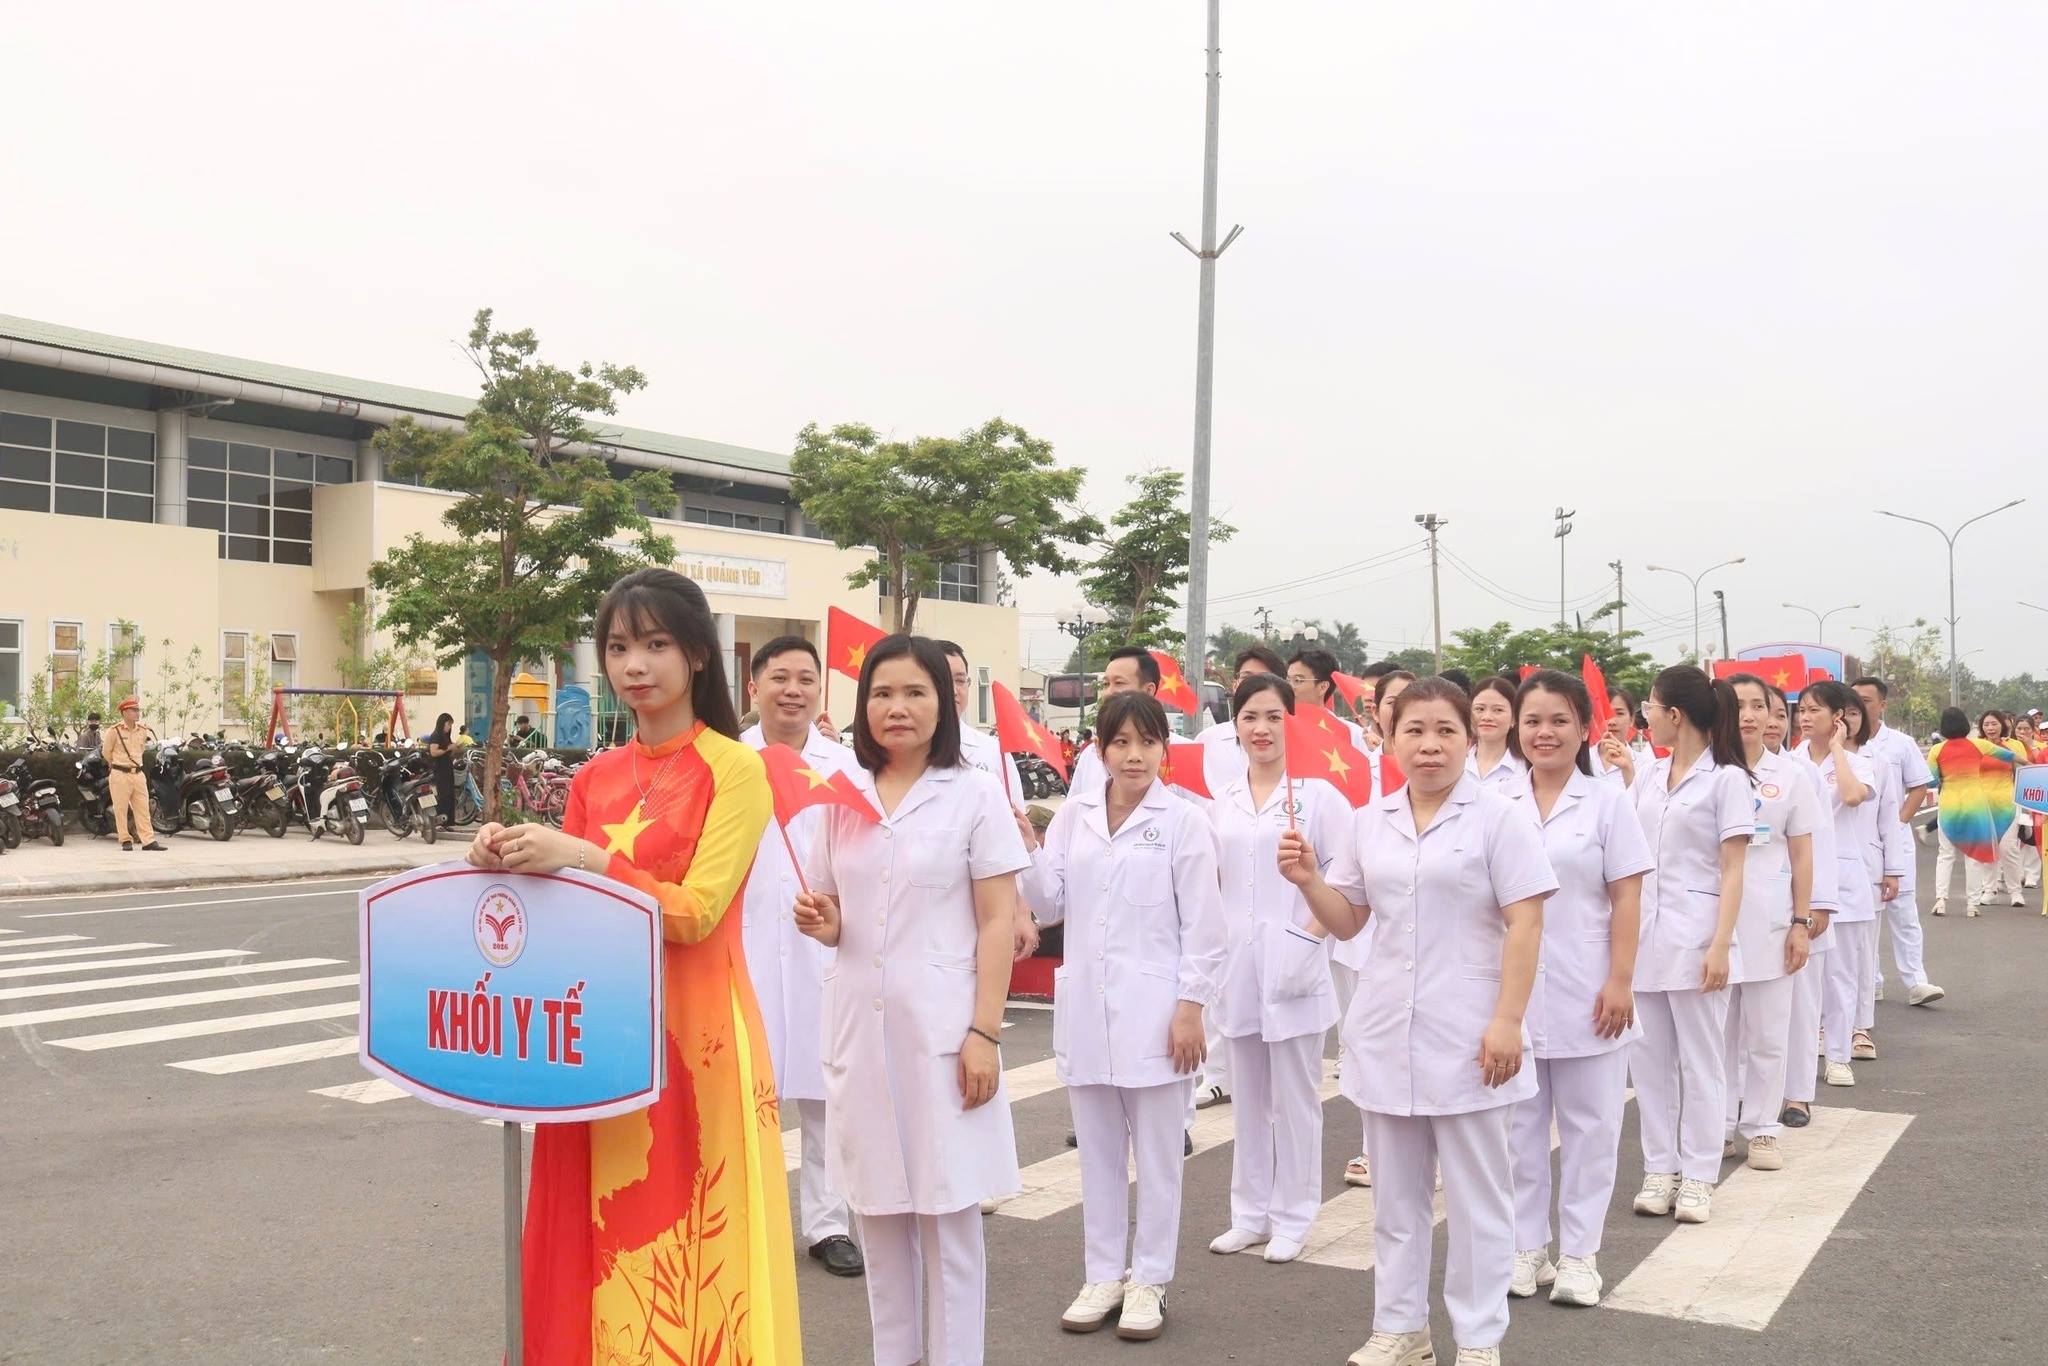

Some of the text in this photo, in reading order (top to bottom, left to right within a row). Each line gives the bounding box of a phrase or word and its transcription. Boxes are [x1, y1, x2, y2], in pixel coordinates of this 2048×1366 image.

[428, 972, 586, 1066] KHỐI Y TẾ
